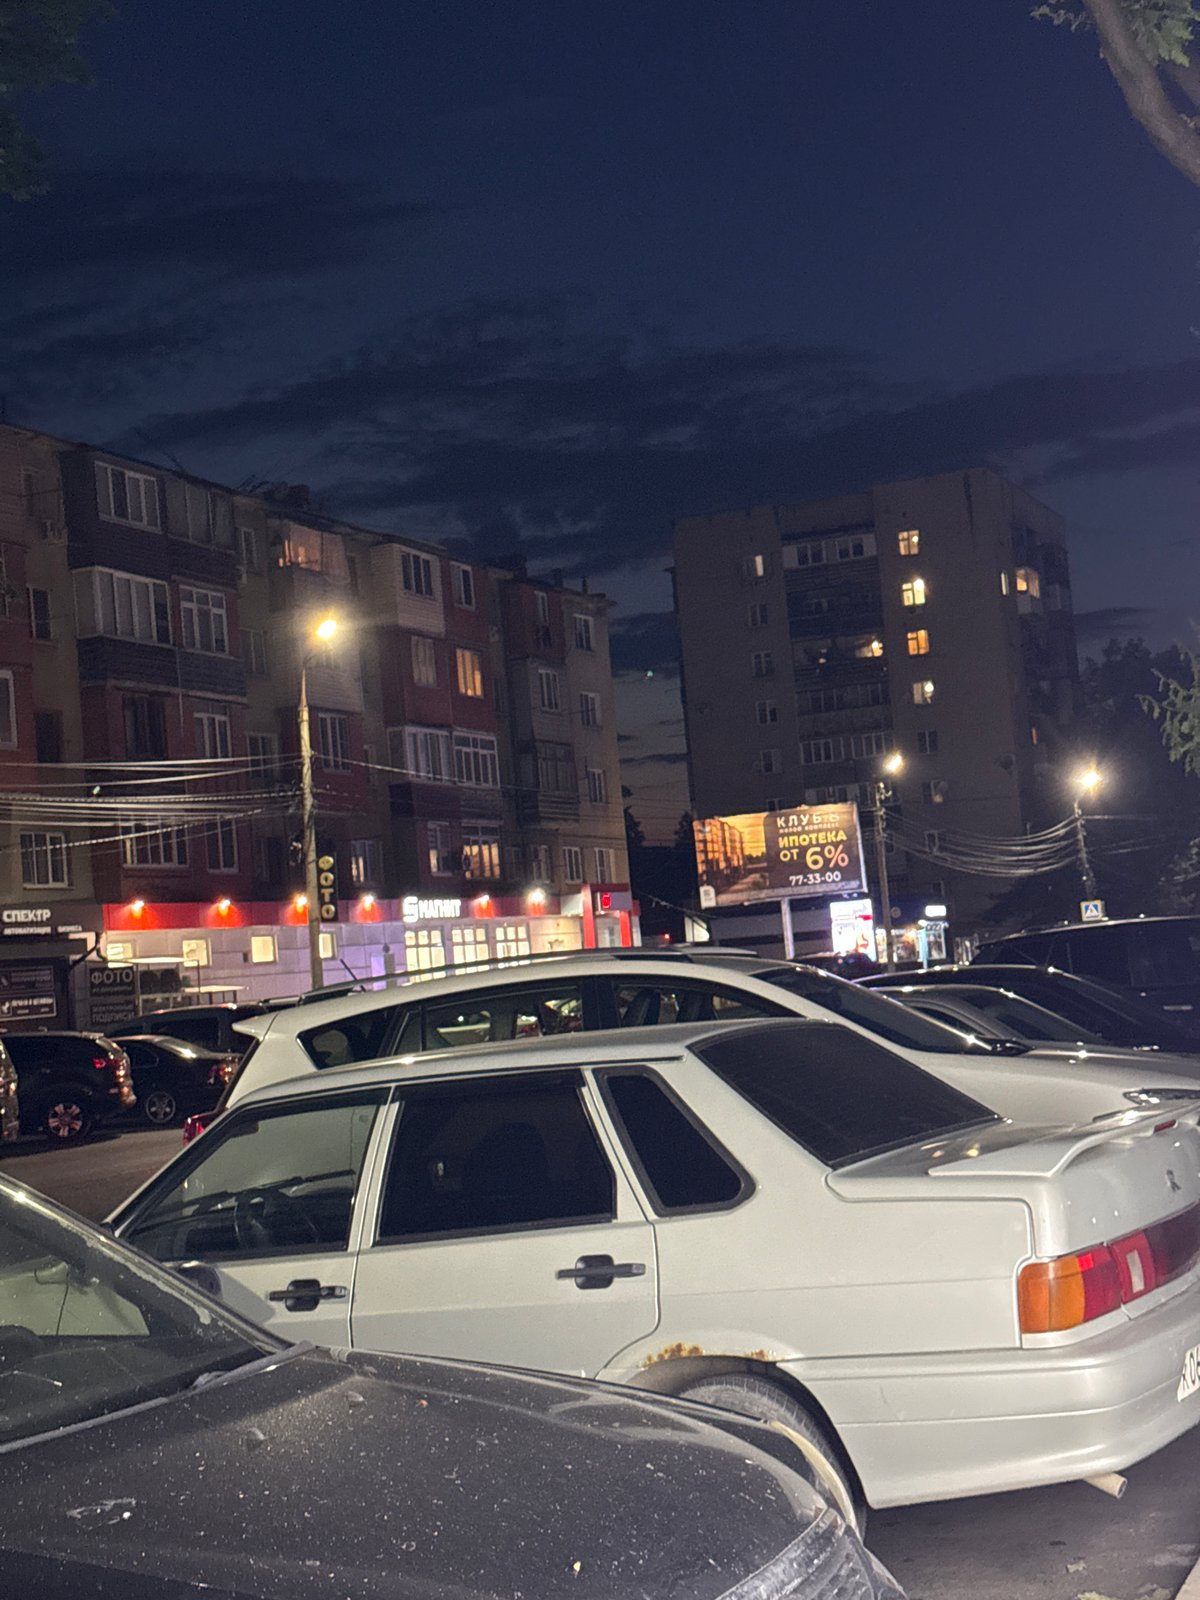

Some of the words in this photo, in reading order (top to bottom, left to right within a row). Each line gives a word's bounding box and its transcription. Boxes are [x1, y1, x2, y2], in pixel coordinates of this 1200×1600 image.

[778, 830, 848, 848] ИПОТЕКА
[780, 849, 799, 861] ОТ
[806, 844, 849, 870] 6%
[789, 871, 841, 886] 77-33-00
[319, 856, 335, 920] ФОТО
[3, 909, 51, 922] СПЕКТР
[91, 969, 133, 984] ФОТО
